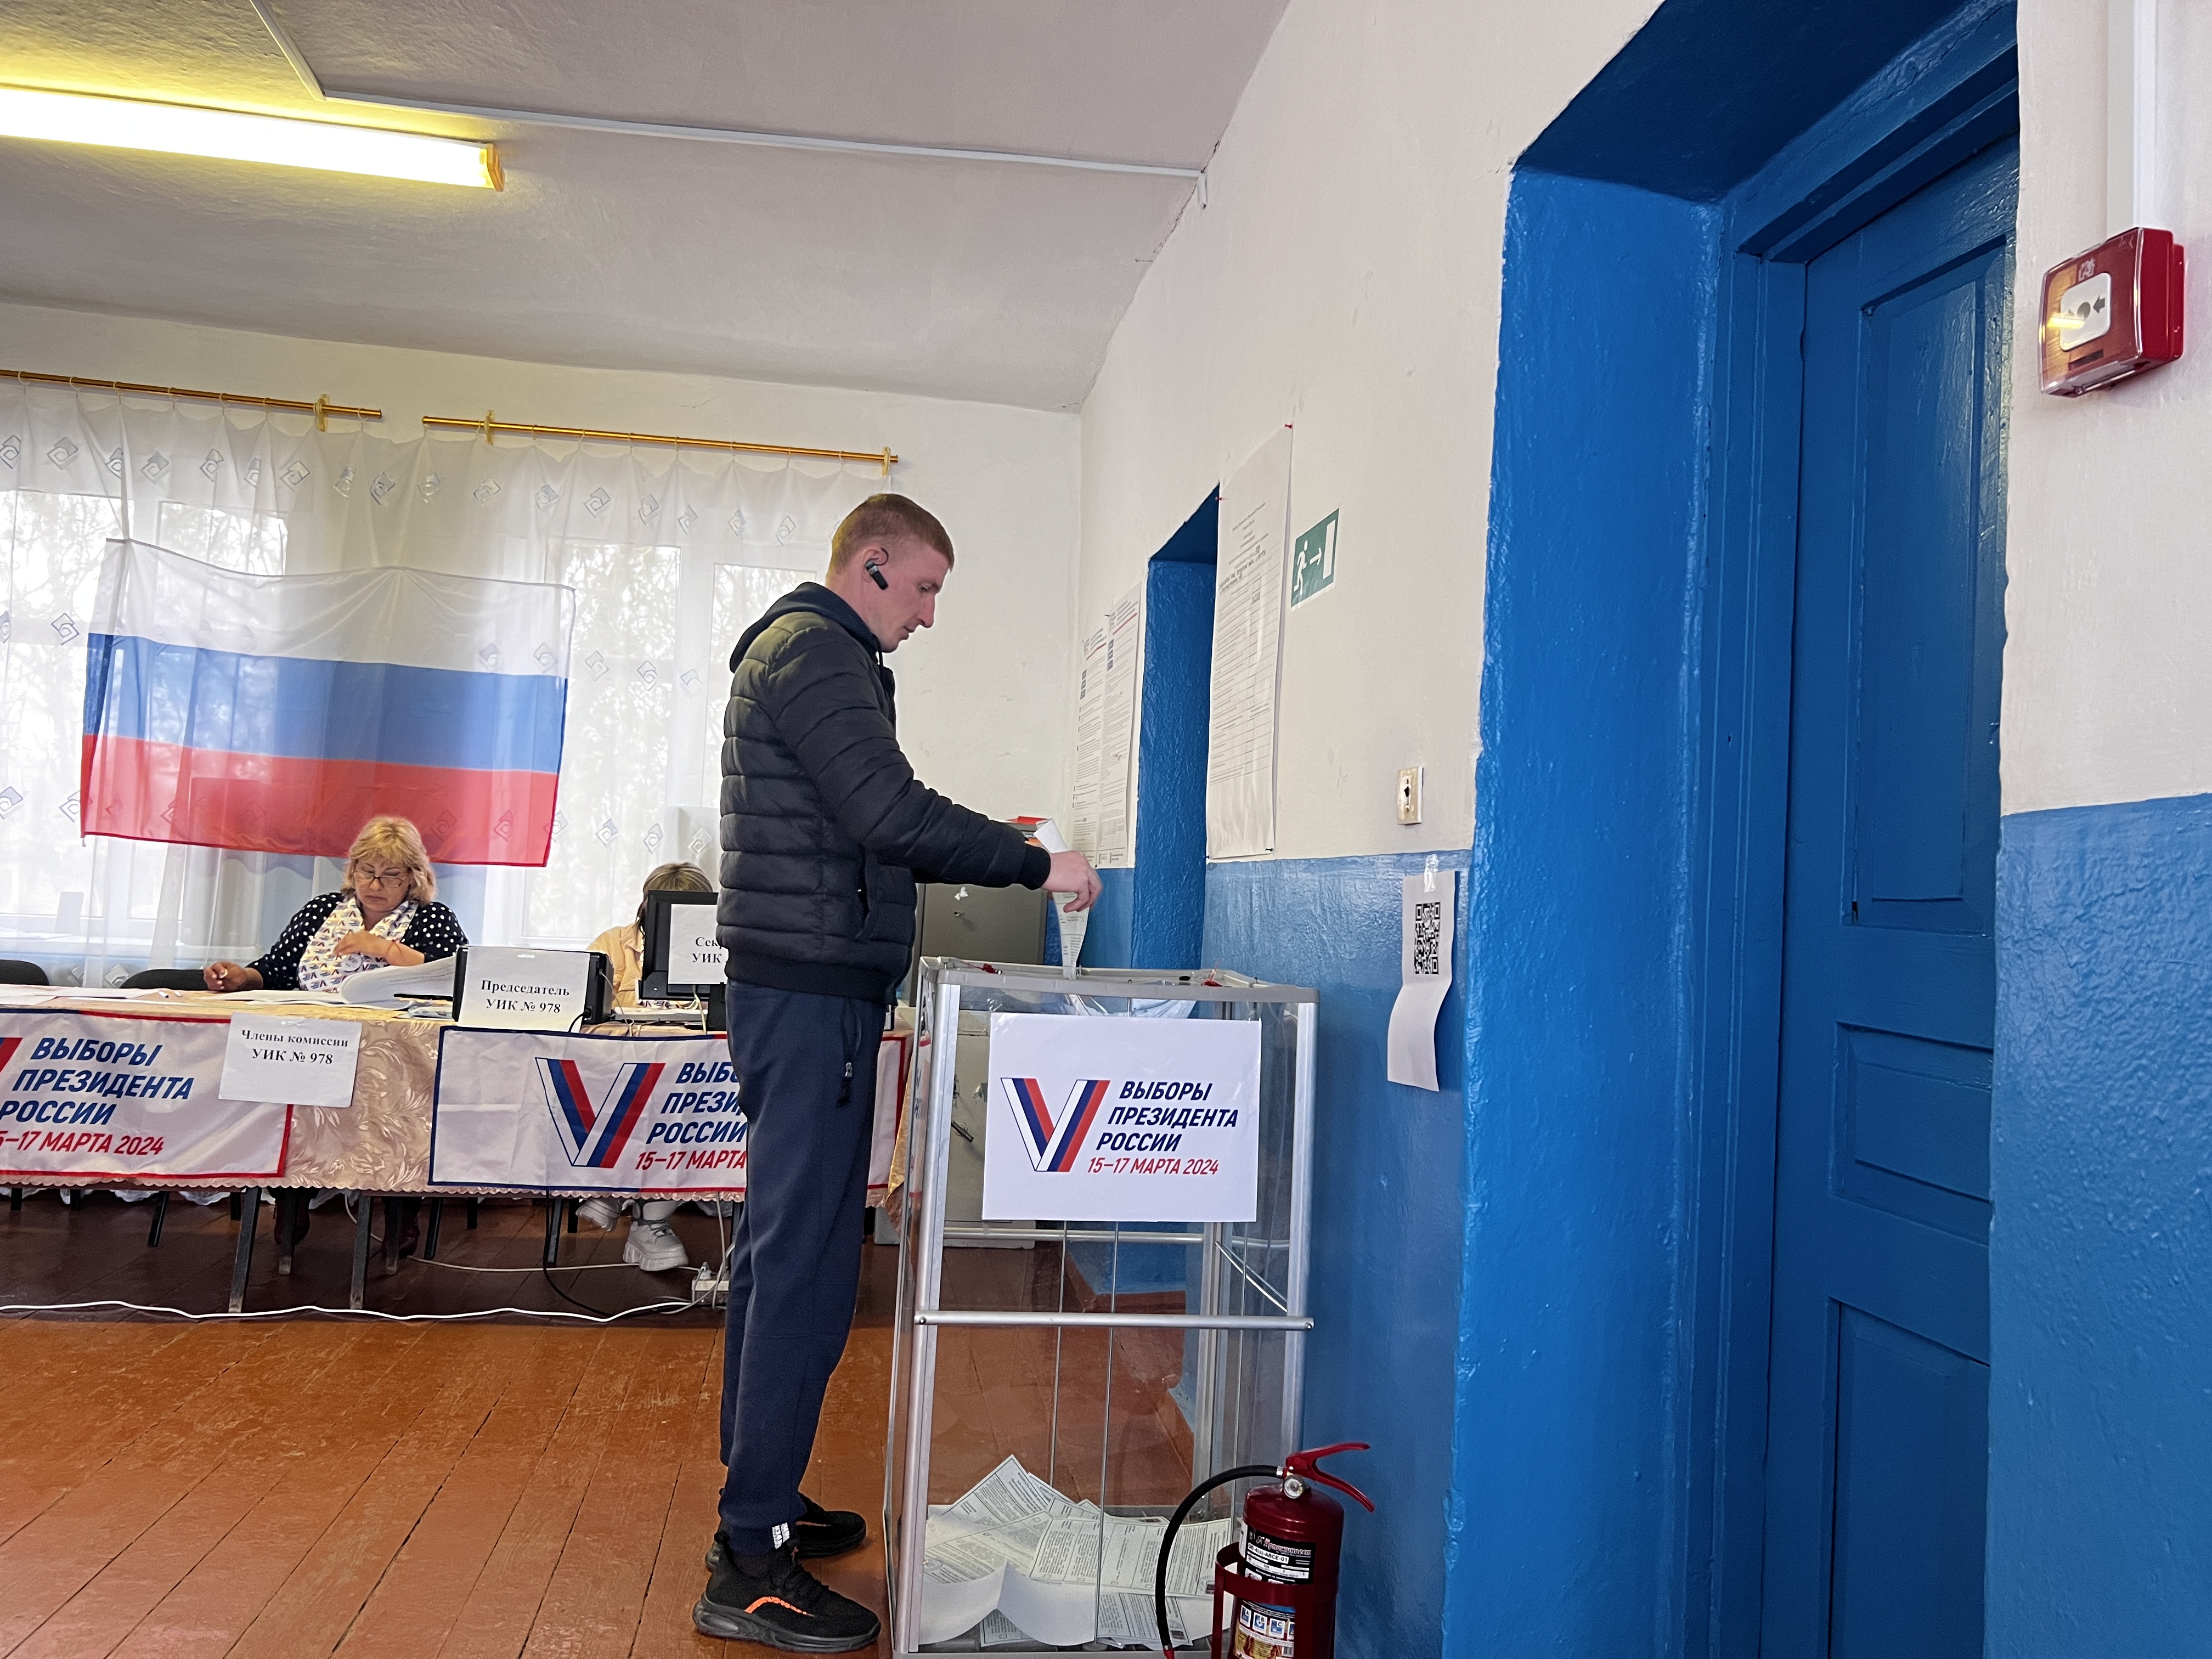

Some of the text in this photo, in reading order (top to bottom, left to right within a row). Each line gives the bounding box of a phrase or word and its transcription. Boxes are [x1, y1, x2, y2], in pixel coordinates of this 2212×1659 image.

[695, 936, 722, 950] Сек
[692, 953, 722, 963] УИК
[481, 980, 569, 996] Председатель
[486, 998, 561, 1013] УИК № 978
[241, 1029, 348, 1047] Члены комиссии
[30, 1037, 163, 1066] ВЫБОРЫ
[252, 1048, 334, 1064] УИК № 978
[12, 1069, 194, 1099] ПРЕЗИДЕНТА
[1119, 1081, 1213, 1101] ВЫБОРЫ
[0, 1101, 117, 1125] РОССИИ
[661, 1091, 742, 1116] ПРЕЗИ
[1108, 1107, 1238, 1128] ПРЕЗИДЕНТА
[646, 1121, 748, 1144] РОССИИ
[1096, 1132, 1182, 1152] РОССИИ
[38, 1131, 113, 1153] МАРТА
[114, 1135, 164, 1155] 2024
[685, 1150, 747, 1169] МАРТА
[1130, 1158, 1181, 1174] МАРТА
[1183, 1159, 1218, 1175] 2024
